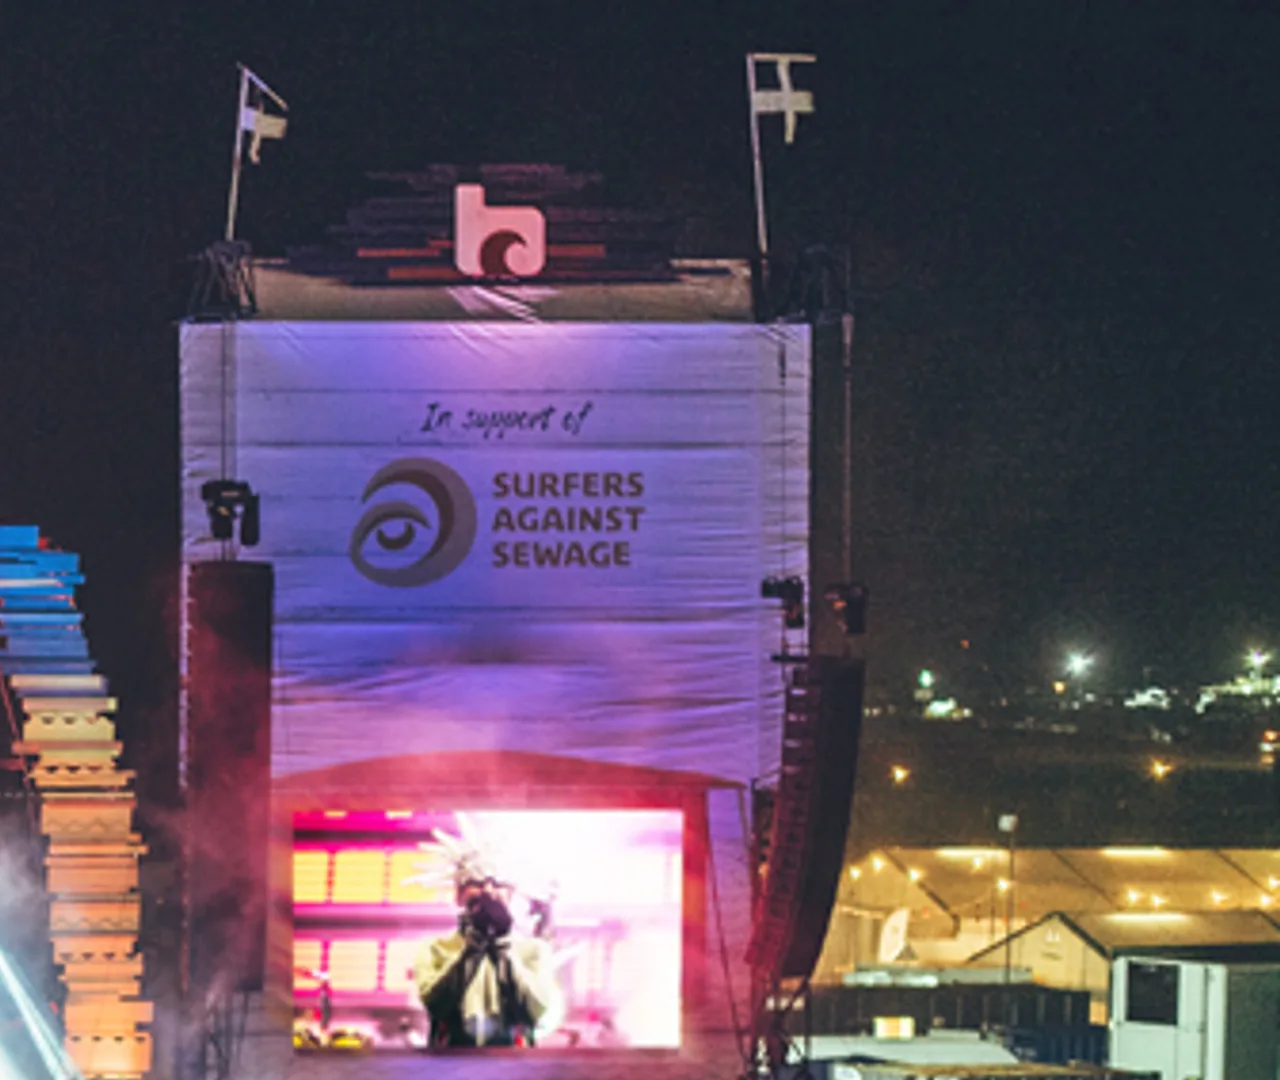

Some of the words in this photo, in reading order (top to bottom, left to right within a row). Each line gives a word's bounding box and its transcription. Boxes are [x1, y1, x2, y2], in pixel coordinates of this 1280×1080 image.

[420, 402, 453, 432] In
[461, 405, 556, 439] support
[561, 401, 594, 436] of
[491, 472, 644, 498] SURFERS
[491, 506, 646, 533] AGAINST
[492, 540, 632, 569] SEWAGE
